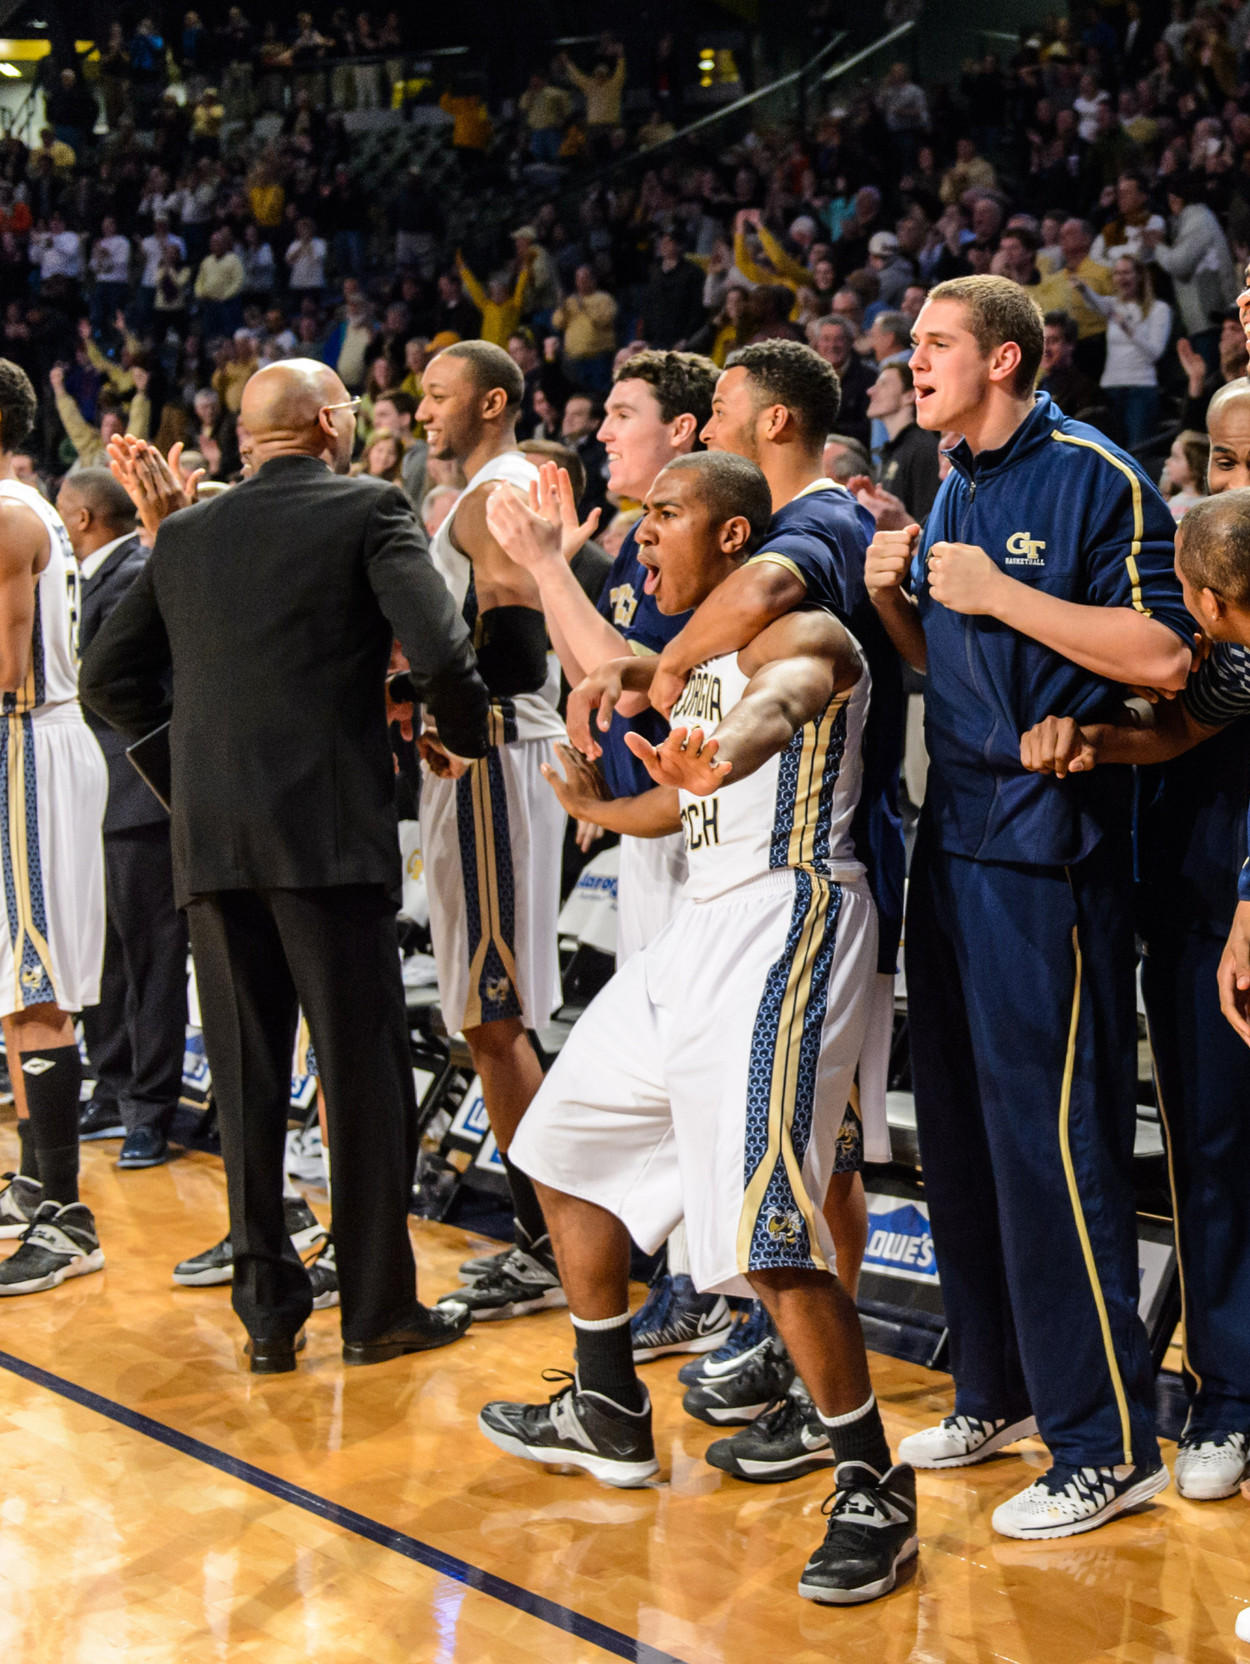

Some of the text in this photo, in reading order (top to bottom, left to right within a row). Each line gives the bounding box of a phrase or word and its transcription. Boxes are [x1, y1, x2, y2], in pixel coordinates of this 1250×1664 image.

[1006, 531, 1046, 559] GT
[1005, 557, 1045, 566] BASKETBALL
[864, 1228, 935, 1268] OWE'S
